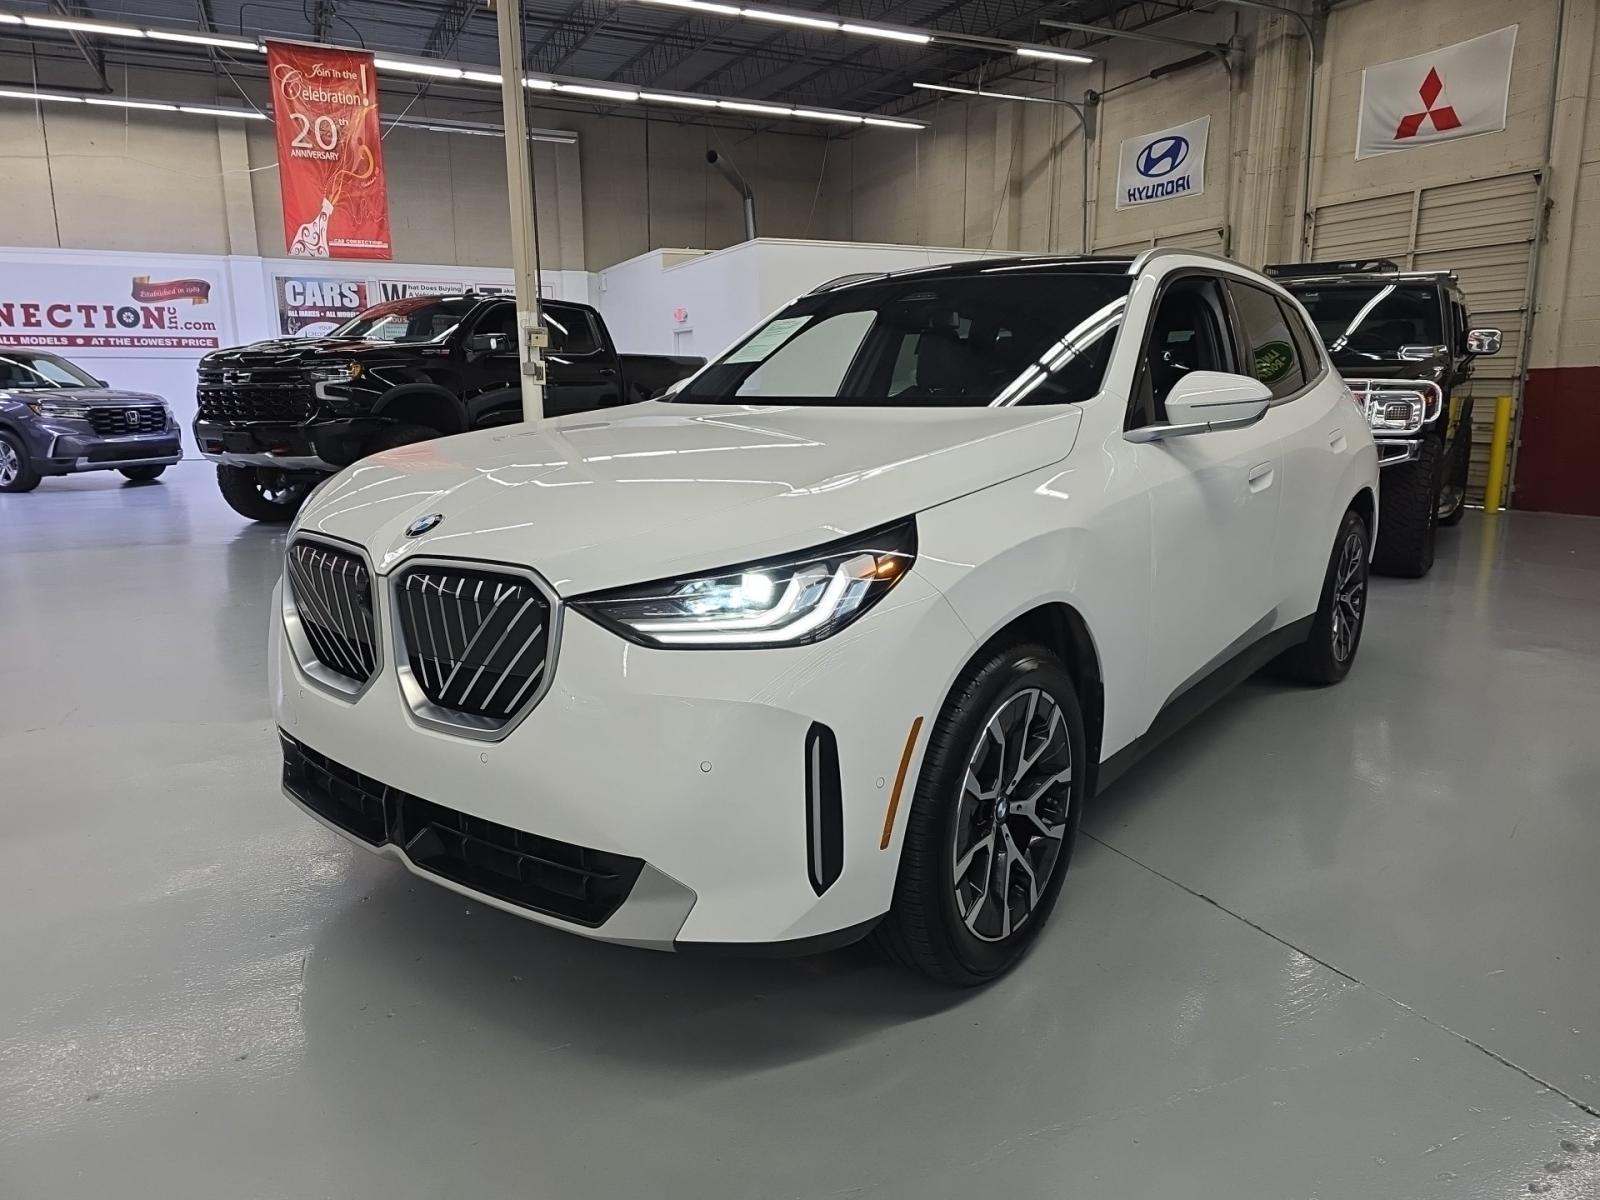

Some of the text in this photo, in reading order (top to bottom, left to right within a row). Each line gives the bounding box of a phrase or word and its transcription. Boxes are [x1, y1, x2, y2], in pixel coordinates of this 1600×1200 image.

[305, 63, 357, 80] Join in the
[290, 149, 340, 160] ANNIVERSARY
[1127, 175, 1191, 202] HYUNDAI
[285, 280, 360, 308] CARS
[438, 285, 462, 293] Buying
[20, 336, 69, 345] MODELS
[91, 337, 106, 346] AT
[107, 337, 131, 346] THE
[134, 338, 180, 347] LOWEST
[181, 338, 215, 347] PRICE
